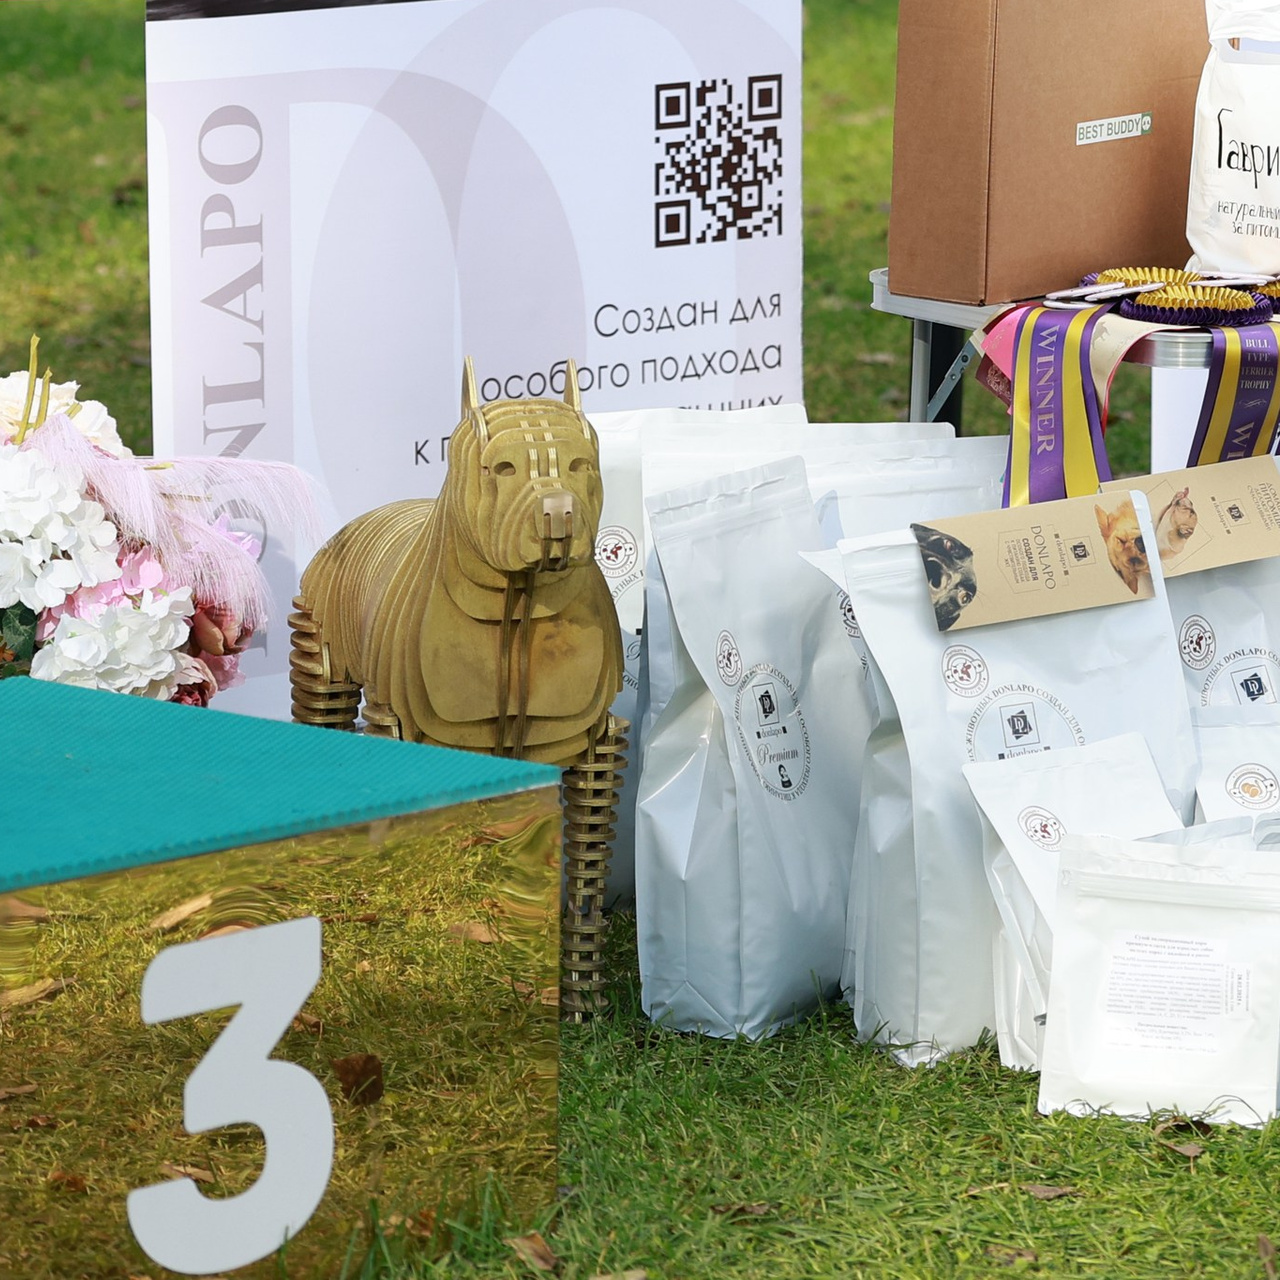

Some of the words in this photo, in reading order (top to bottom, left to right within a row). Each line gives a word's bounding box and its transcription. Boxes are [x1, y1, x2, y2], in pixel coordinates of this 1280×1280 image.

[1078, 124, 1104, 140] BEST
[1107, 118, 1140, 136] BUDDY
[1218, 200, 1280, 221] натуральный
[1232, 222, 1243, 234] за
[593, 303, 718, 339] Создан
[730, 292, 783, 322] для
[198, 104, 268, 565] NLAPO
[1245, 339, 1271, 349] BULL
[641, 341, 783, 387] подхода
[1247, 352, 1271, 362] TYPE
[1241, 366, 1274, 376] TERRIER
[1036, 325, 1061, 456] WINNER
[1240, 380, 1271, 389] TROPHY
[413, 440, 430, 466] к
[1021, 537, 1034, 565] СОЗДАН
[1028, 565, 1038, 581] ДЛЯ
[1030, 525, 1056, 590] DONLAPO
[1223, 648, 1267, 663] DONLAPO
[966, 694, 993, 745] ЖИВОТНЫХ
[992, 684, 1035, 698] DONLAPO
[1036, 689, 1070, 716] СОЗДАН
[1066, 713, 1082, 735] ДЛЯ
[757, 743, 799, 766] Premium
[126, 916, 335, 1274] 3
